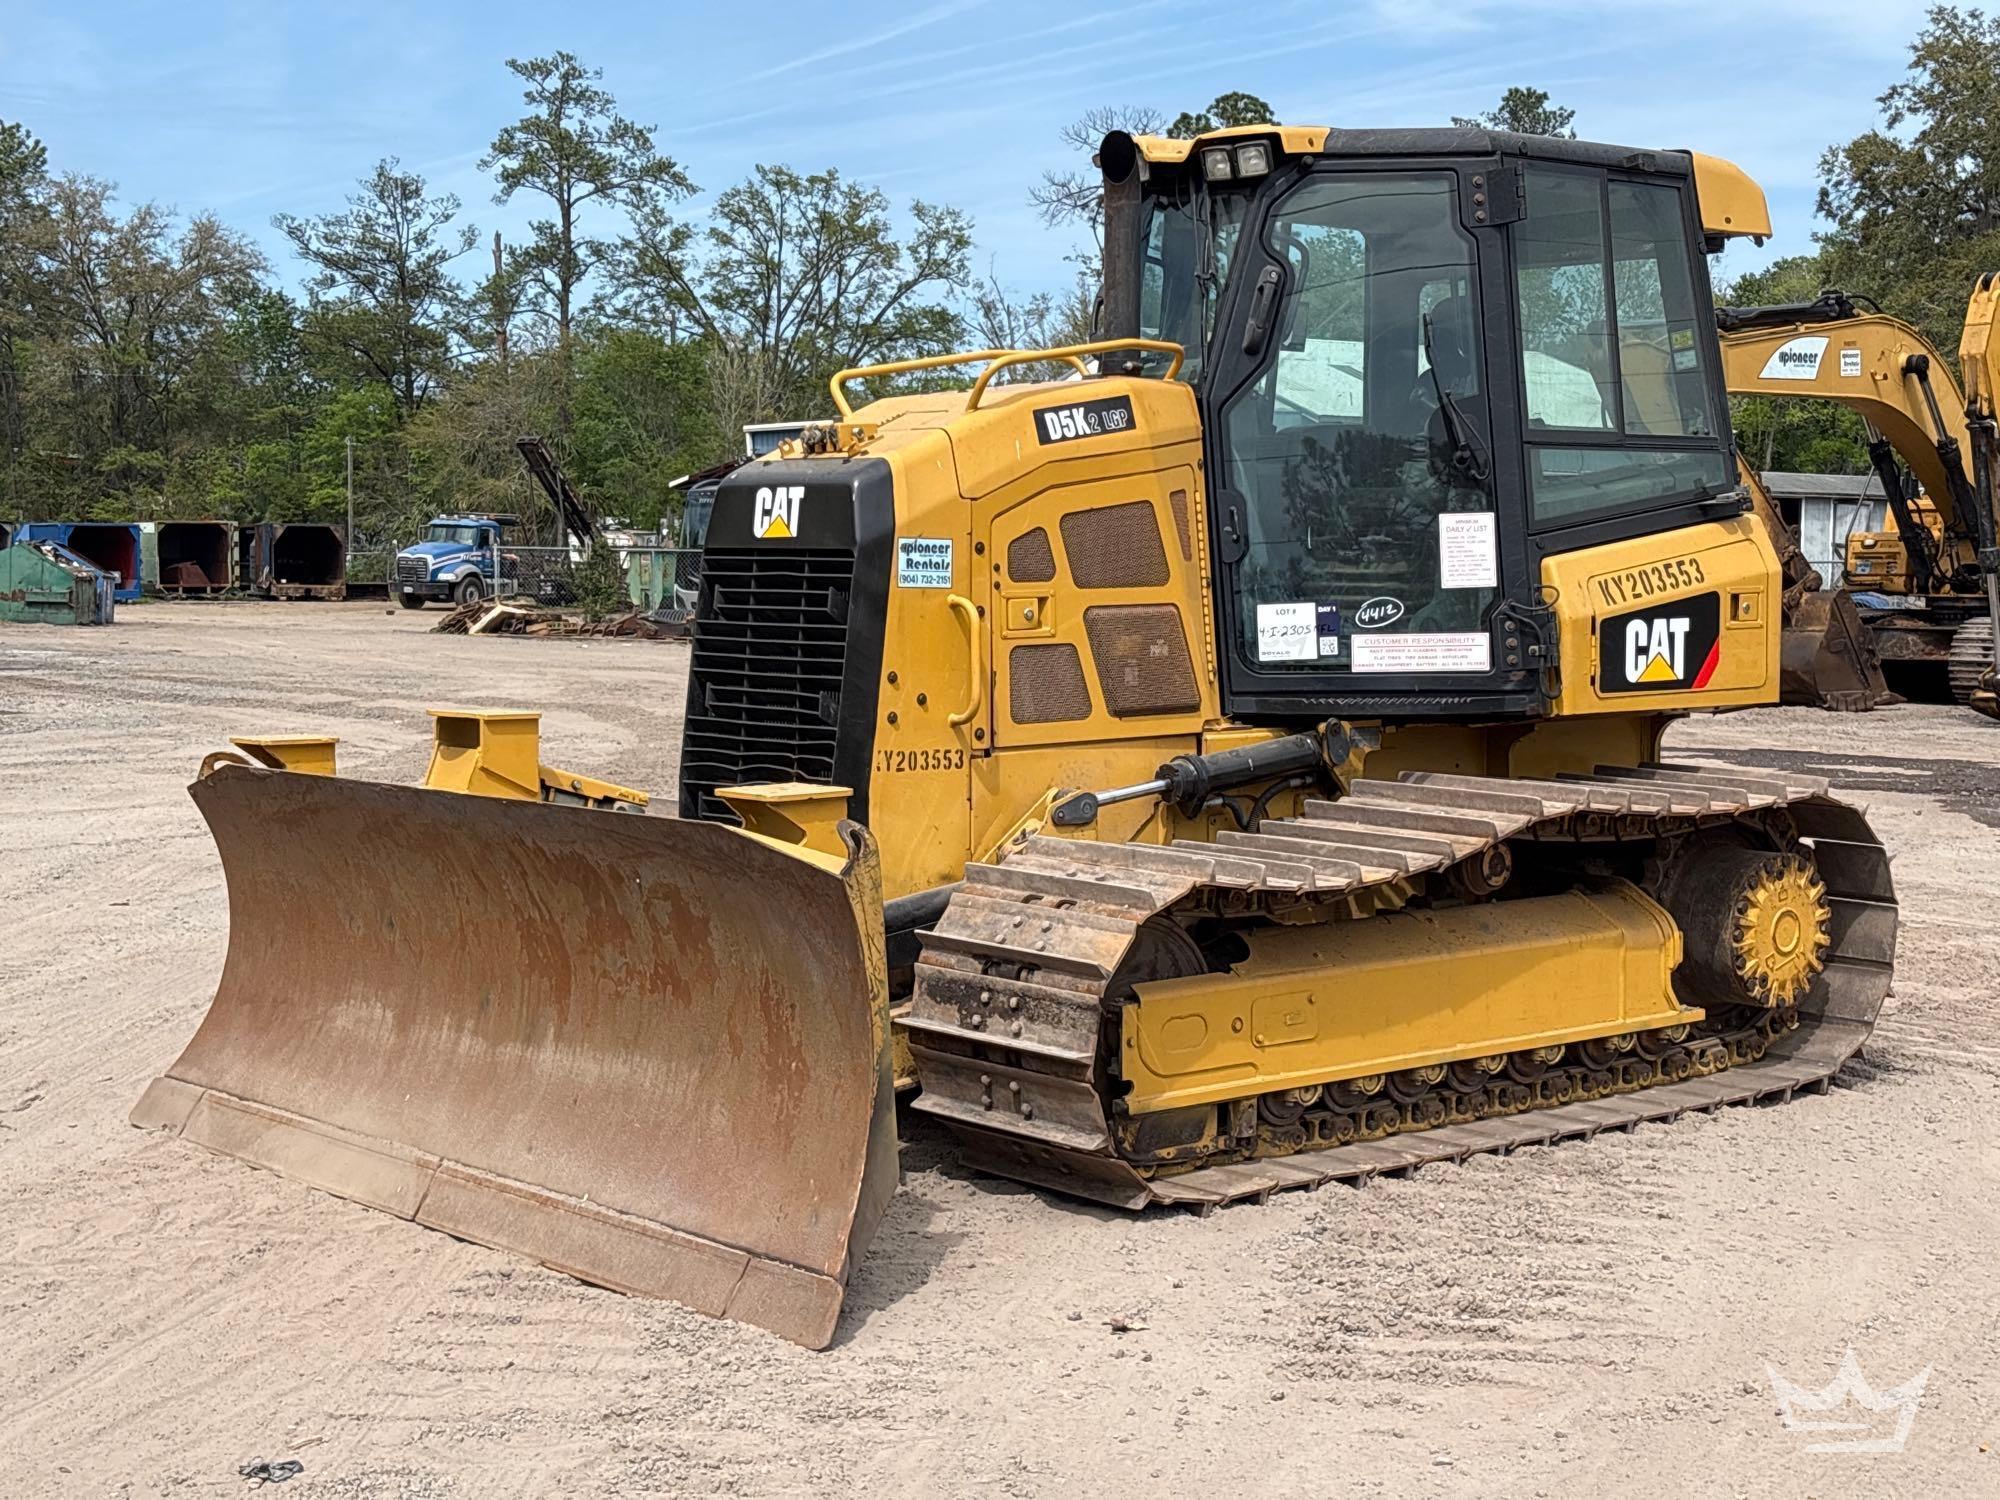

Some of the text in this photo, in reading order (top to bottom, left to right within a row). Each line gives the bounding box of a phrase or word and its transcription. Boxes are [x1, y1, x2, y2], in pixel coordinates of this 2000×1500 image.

[1102, 409, 1128, 430] LGP
[753, 486, 805, 539] CAT
[1474, 525, 1488, 533] LIST
[906, 558, 950, 570] Rentals
[900, 574, 951, 585] (904) 732-2151
[1597, 557, 1705, 606] KY203553
[1276, 608, 1290, 616] LOT
[1361, 604, 1397, 622] 4412
[1364, 637, 1477, 646] CUSTOMER RESPONSIBILITY
[1625, 617, 1690, 684] CAT
